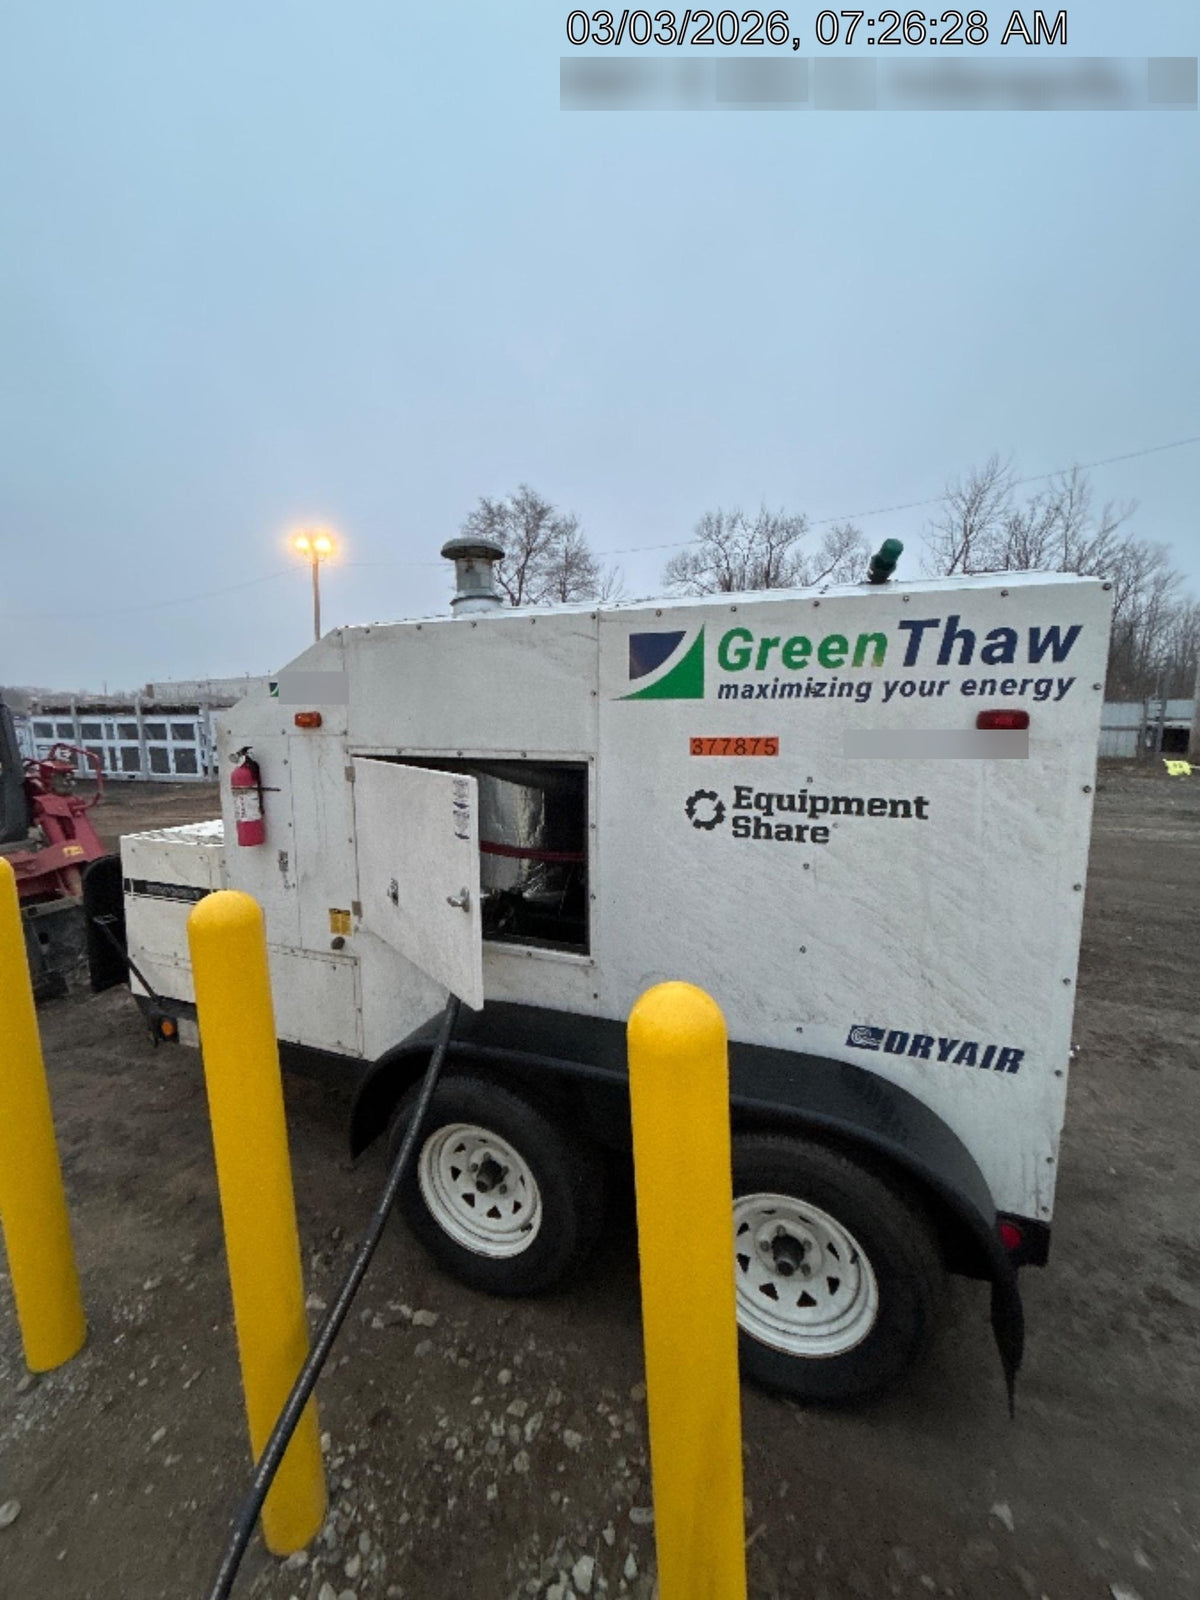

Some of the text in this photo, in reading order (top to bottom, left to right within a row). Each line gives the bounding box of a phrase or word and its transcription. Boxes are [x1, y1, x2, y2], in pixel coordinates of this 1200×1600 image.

[717, 676, 1076, 703] maximizing your energy
[692, 737, 777, 756] 377875
[732, 785, 930, 820] Equipment
[731, 815, 831, 844] Share
[883, 1030, 1025, 1075] DRYAIR
